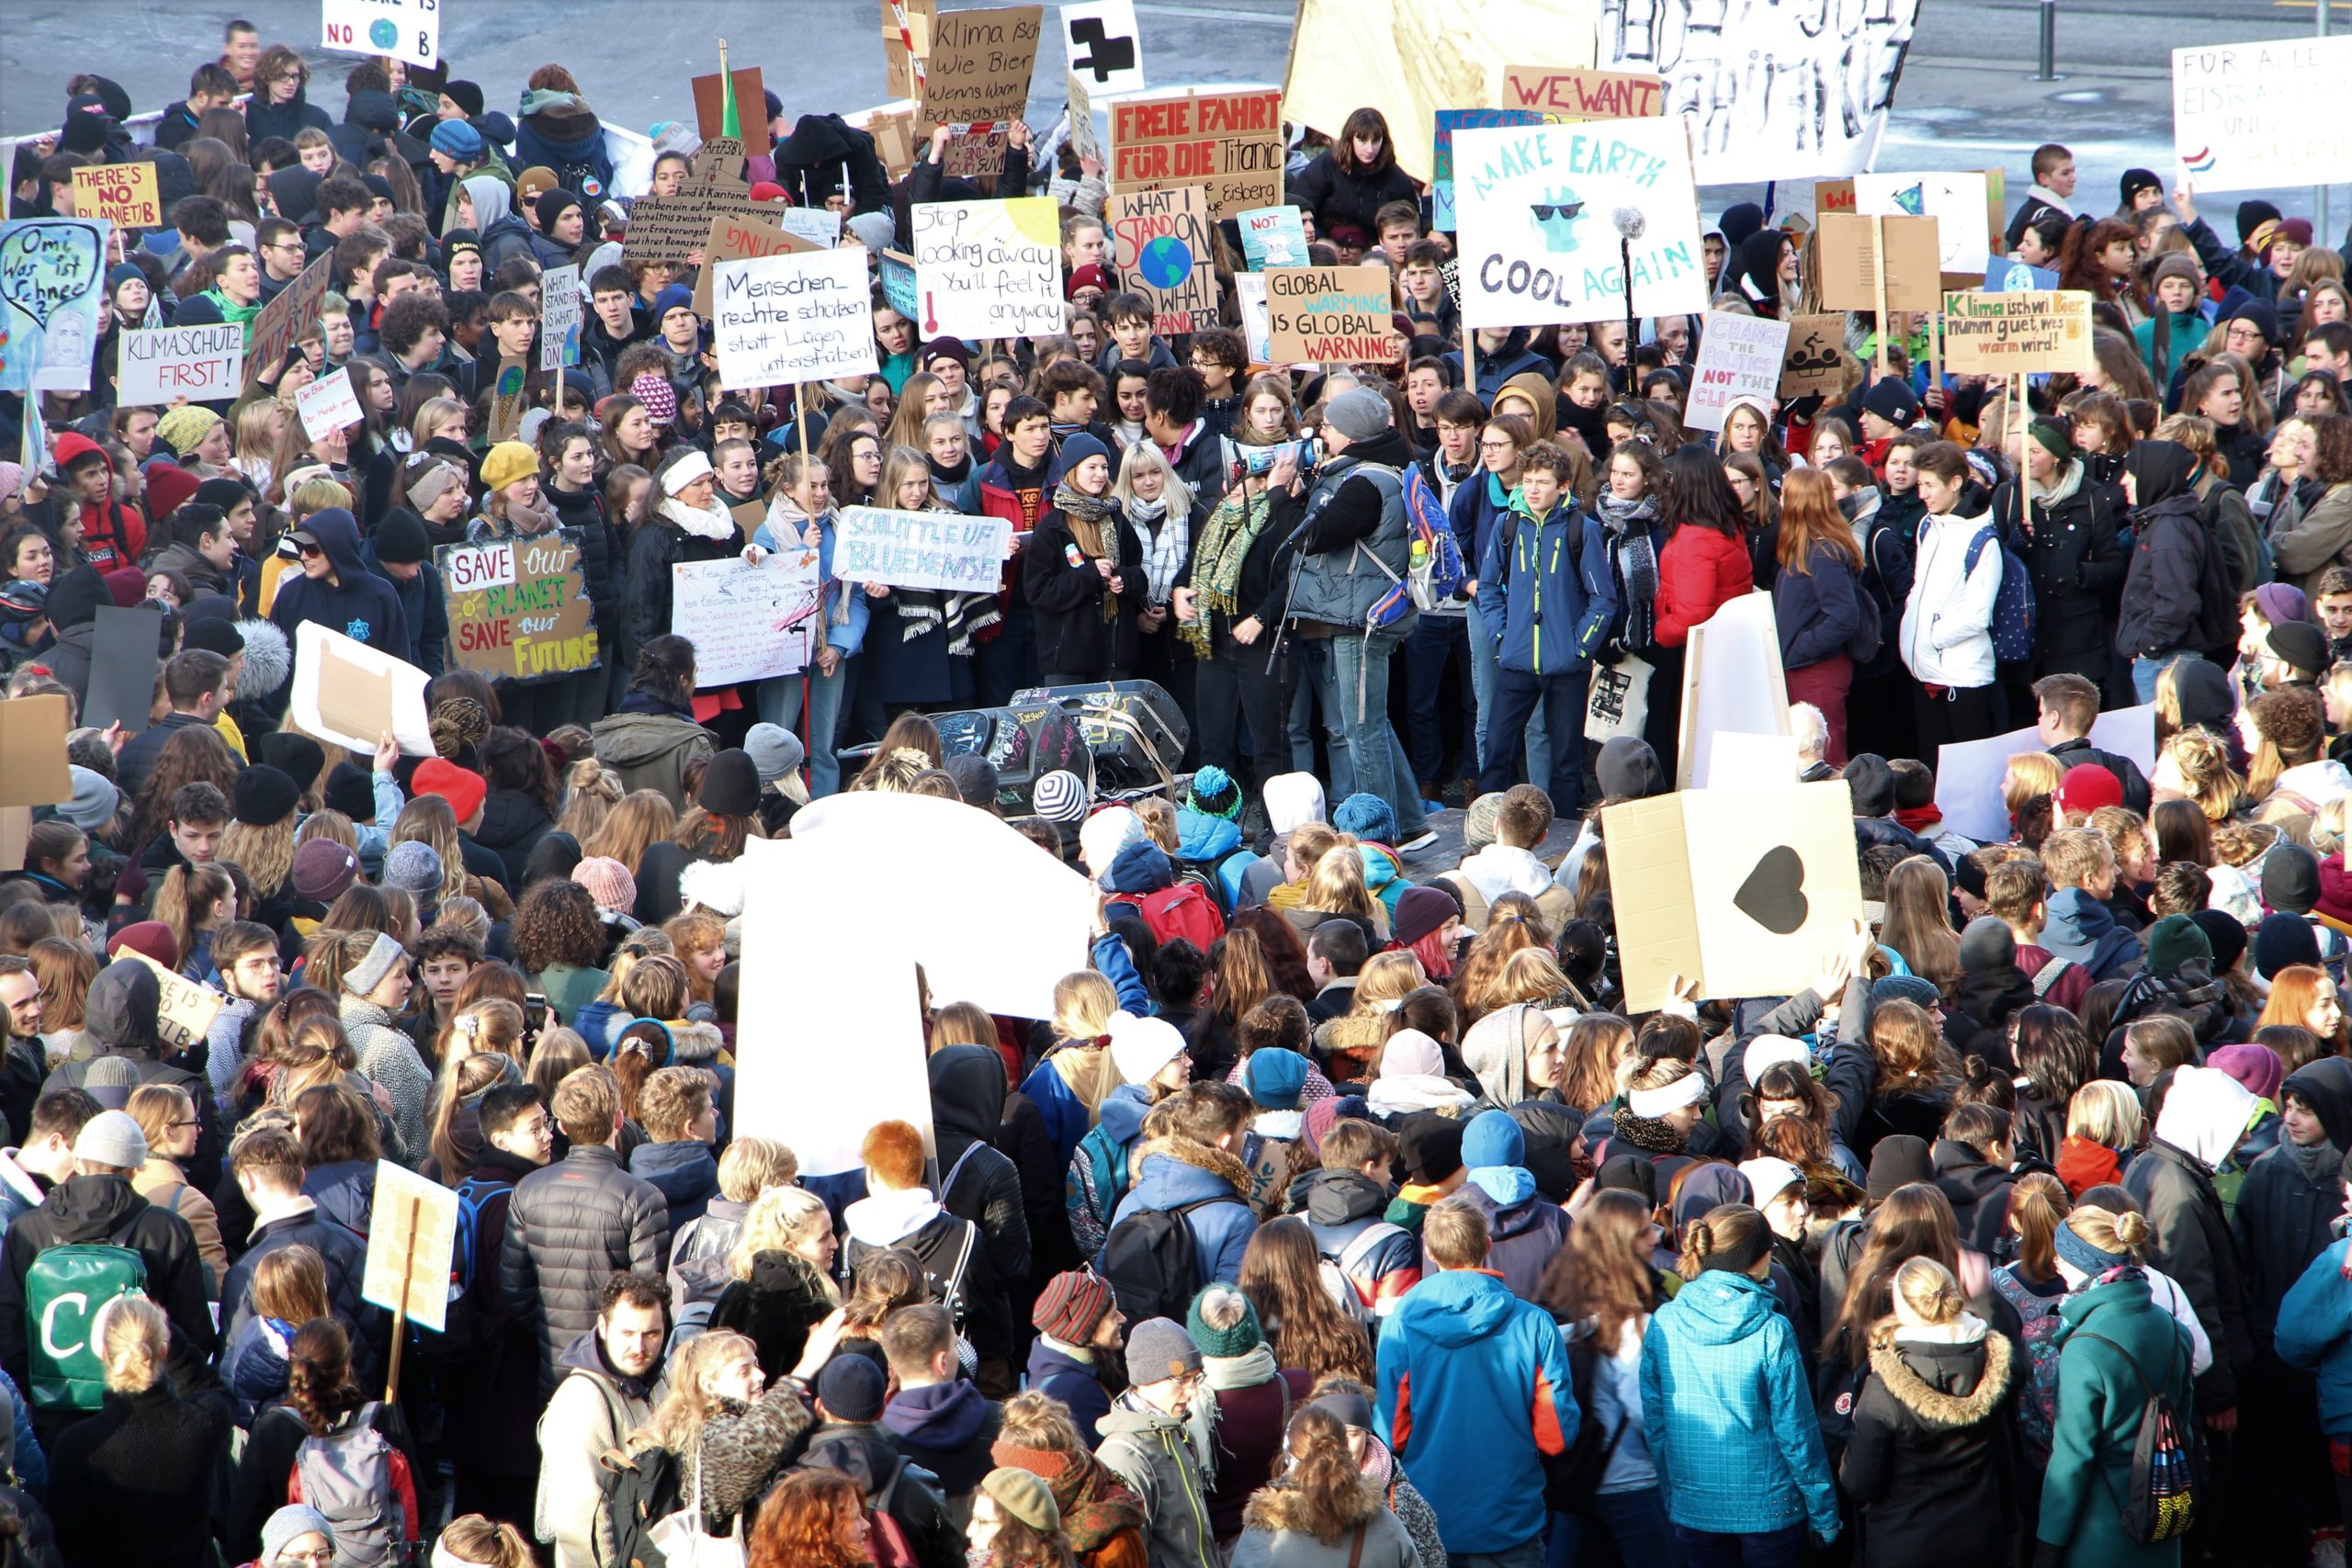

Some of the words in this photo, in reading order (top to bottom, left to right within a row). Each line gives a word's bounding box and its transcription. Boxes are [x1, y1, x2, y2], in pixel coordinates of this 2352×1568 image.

[327, 23, 353, 44] NO
[418, 30, 430, 57] B
[935, 18, 1003, 49] Klima
[1012, 17, 1041, 42] isch
[989, 51, 1033, 73] Bier
[2183, 51, 2238, 76] FÜR
[2258, 47, 2322, 73] ALLE
[1510, 74, 1571, 110] WE
[1574, 76, 1660, 117] WANT
[1117, 101, 1190, 143] FREIE
[1198, 93, 1282, 133] FAHRT
[1116, 143, 1170, 181] FÜR
[1173, 141, 1216, 177] DIE
[1219, 138, 1283, 174] Titanic
[1471, 132, 1554, 203] MAKE
[1568, 133, 1668, 188] EARTH
[75, 165, 141, 189] THERE'S
[98, 185, 132, 204] NO
[676, 186, 696, 198] Bund
[698, 186, 705, 195] &
[1123, 190, 1177, 218] WHAT
[1185, 188, 1190, 212] I
[1223, 181, 1275, 207] Eisberg
[676, 213, 712, 223] zwischen
[690, 201, 706, 213] auf
[707, 200, 733, 213] Dauer
[628, 224, 649, 234] ihrer
[915, 205, 968, 237] Stop
[1250, 215, 1280, 231] NOT
[625, 236, 640, 246] und
[641, 235, 663, 246] ihrer
[1114, 214, 1174, 270] STAND
[1174, 212, 1212, 261] ON
[4, 254, 38, 279] Was
[56, 254, 81, 279] ist
[622, 248, 662, 260] Menschen
[988, 246, 1055, 283] away
[546, 275, 569, 294] WHAT
[571, 274, 575, 288] I
[943, 271, 987, 292] You'll
[994, 269, 1035, 298] feel
[1041, 282, 1056, 298] it
[1159, 260, 1213, 313] WHAT
[1272, 271, 1345, 296] GLOBAL
[1479, 253, 1573, 309] COOL
[1583, 241, 1695, 302] AGAIN
[7, 277, 85, 302] Schnee
[545, 292, 570, 310] STAND
[722, 301, 789, 329] rechte
[1302, 293, 1390, 314] WARMING
[1947, 293, 2005, 318] Klima
[2007, 293, 2031, 316] isch
[2031, 297, 2050, 314] wi
[546, 312, 554, 328] IS
[555, 309, 573, 325] WHAT
[575, 308, 579, 321] I
[989, 303, 1060, 334] anyway
[1189, 308, 1220, 333] FOR
[1272, 313, 1290, 333] IS
[1295, 314, 1382, 335] GLOBAL
[1948, 317, 1993, 336] nümm
[2041, 318, 2064, 331] wes
[128, 325, 241, 362] KLIMASCHUTZ
[243, 285, 326, 391] FANTASTIC
[544, 331, 566, 347] STAND
[729, 332, 776, 353] statt
[785, 328, 844, 352] Lügen
[1711, 317, 1787, 349] CHANGE
[1978, 341, 2019, 355] warm
[2020, 332, 2059, 353] wird!
[545, 346, 560, 367] ON
[1304, 335, 1394, 361] WARNING
[1702, 345, 1772, 374] POLITICS
[1728, 341, 1756, 354] THE
[1702, 369, 1736, 386] NOT
[1741, 373, 1774, 390] THE
[848, 510, 959, 546] SCHLITTLE
[963, 523, 997, 547] UF
[455, 549, 511, 585] SAVE
[522, 544, 577, 575] our
[487, 575, 567, 618] PLANET
[459, 619, 513, 652] SAVE
[517, 612, 560, 636] our
[180, 989, 199, 1009] IS
